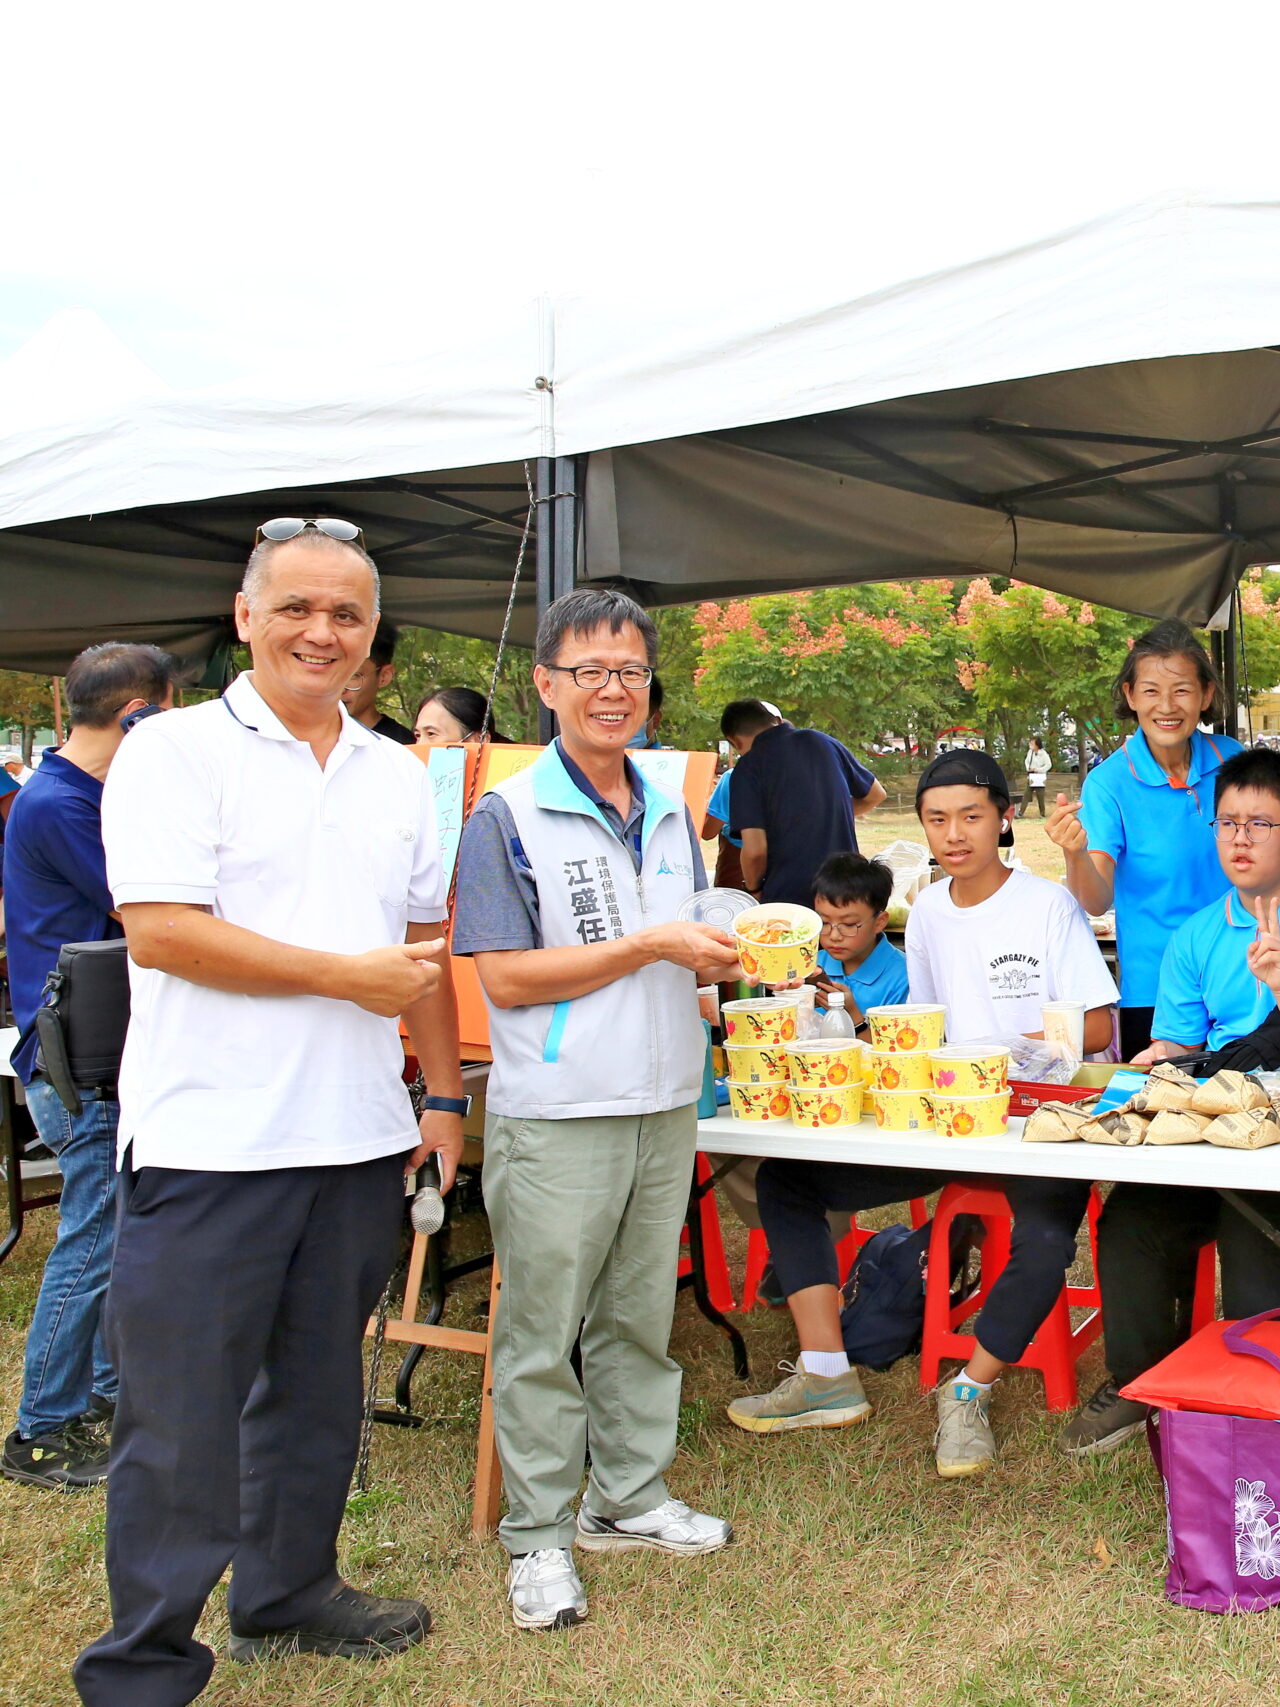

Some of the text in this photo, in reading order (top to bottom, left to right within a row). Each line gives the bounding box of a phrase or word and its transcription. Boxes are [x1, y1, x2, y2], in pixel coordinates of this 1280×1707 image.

[563, 859, 607, 945] 江盛任
[595, 856, 624, 939] 環境保護局局長
[990, 953, 1040, 969] STARGAZY PIE
